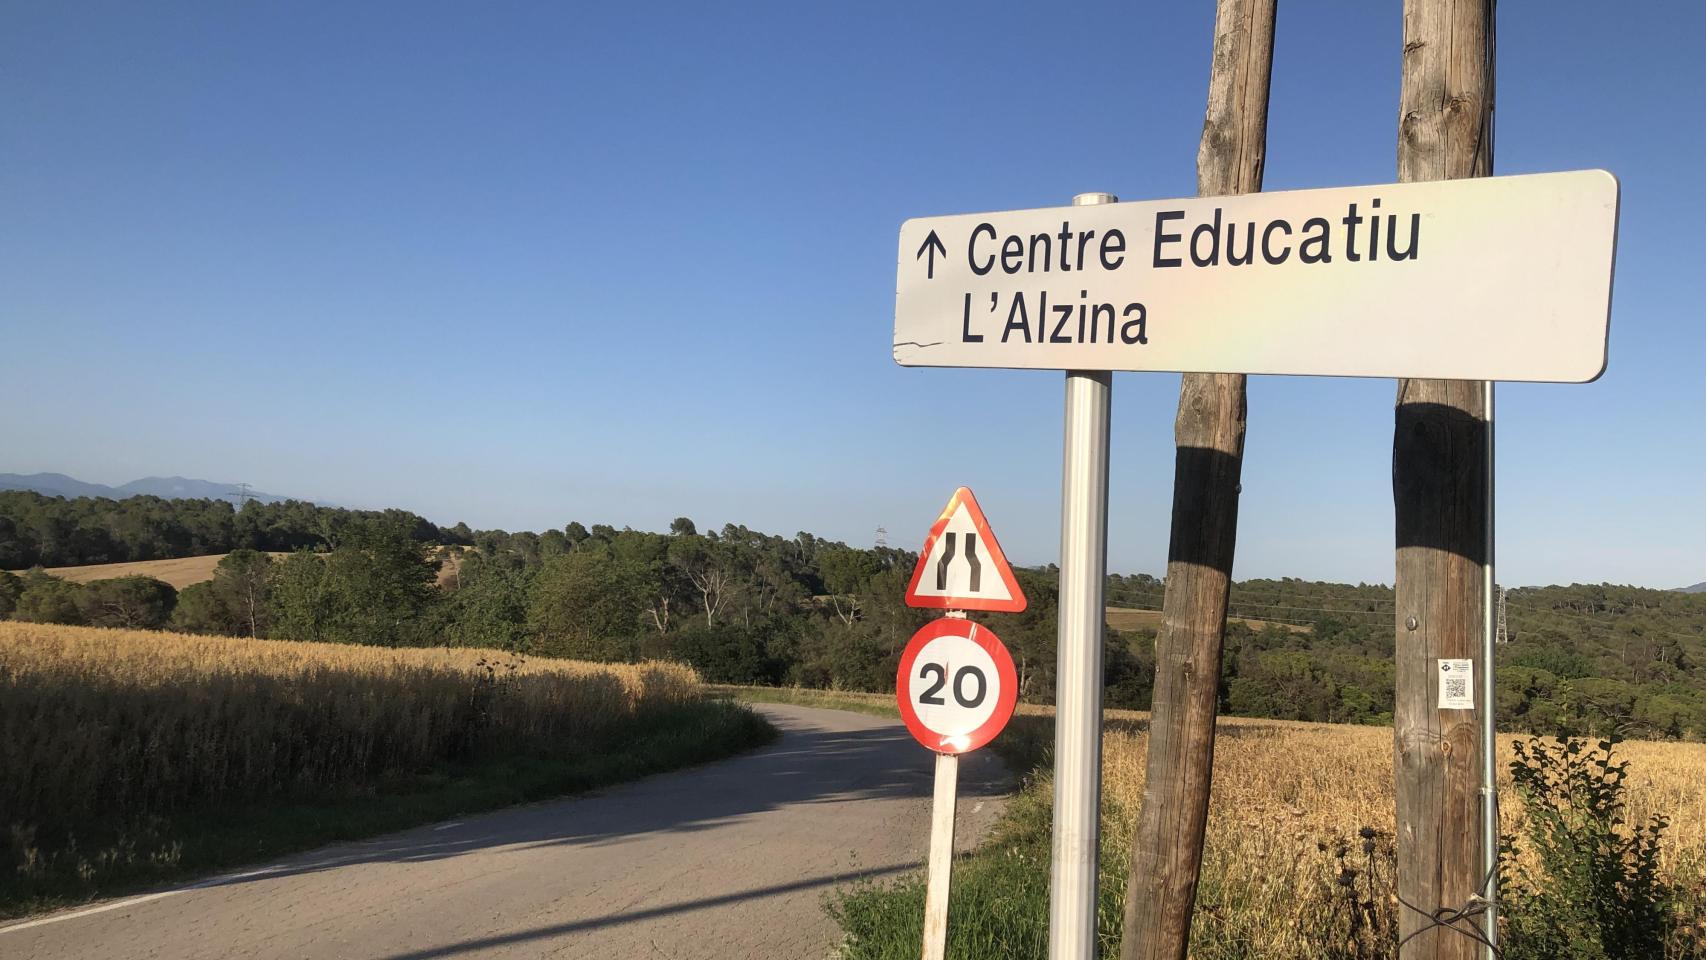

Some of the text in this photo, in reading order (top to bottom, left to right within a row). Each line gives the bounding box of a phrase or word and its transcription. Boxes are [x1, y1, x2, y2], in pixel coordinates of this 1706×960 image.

[968, 199, 1421, 276] Centre Educatiu
[963, 290, 1148, 345] L'Alzina
[919, 663, 987, 708] 20
